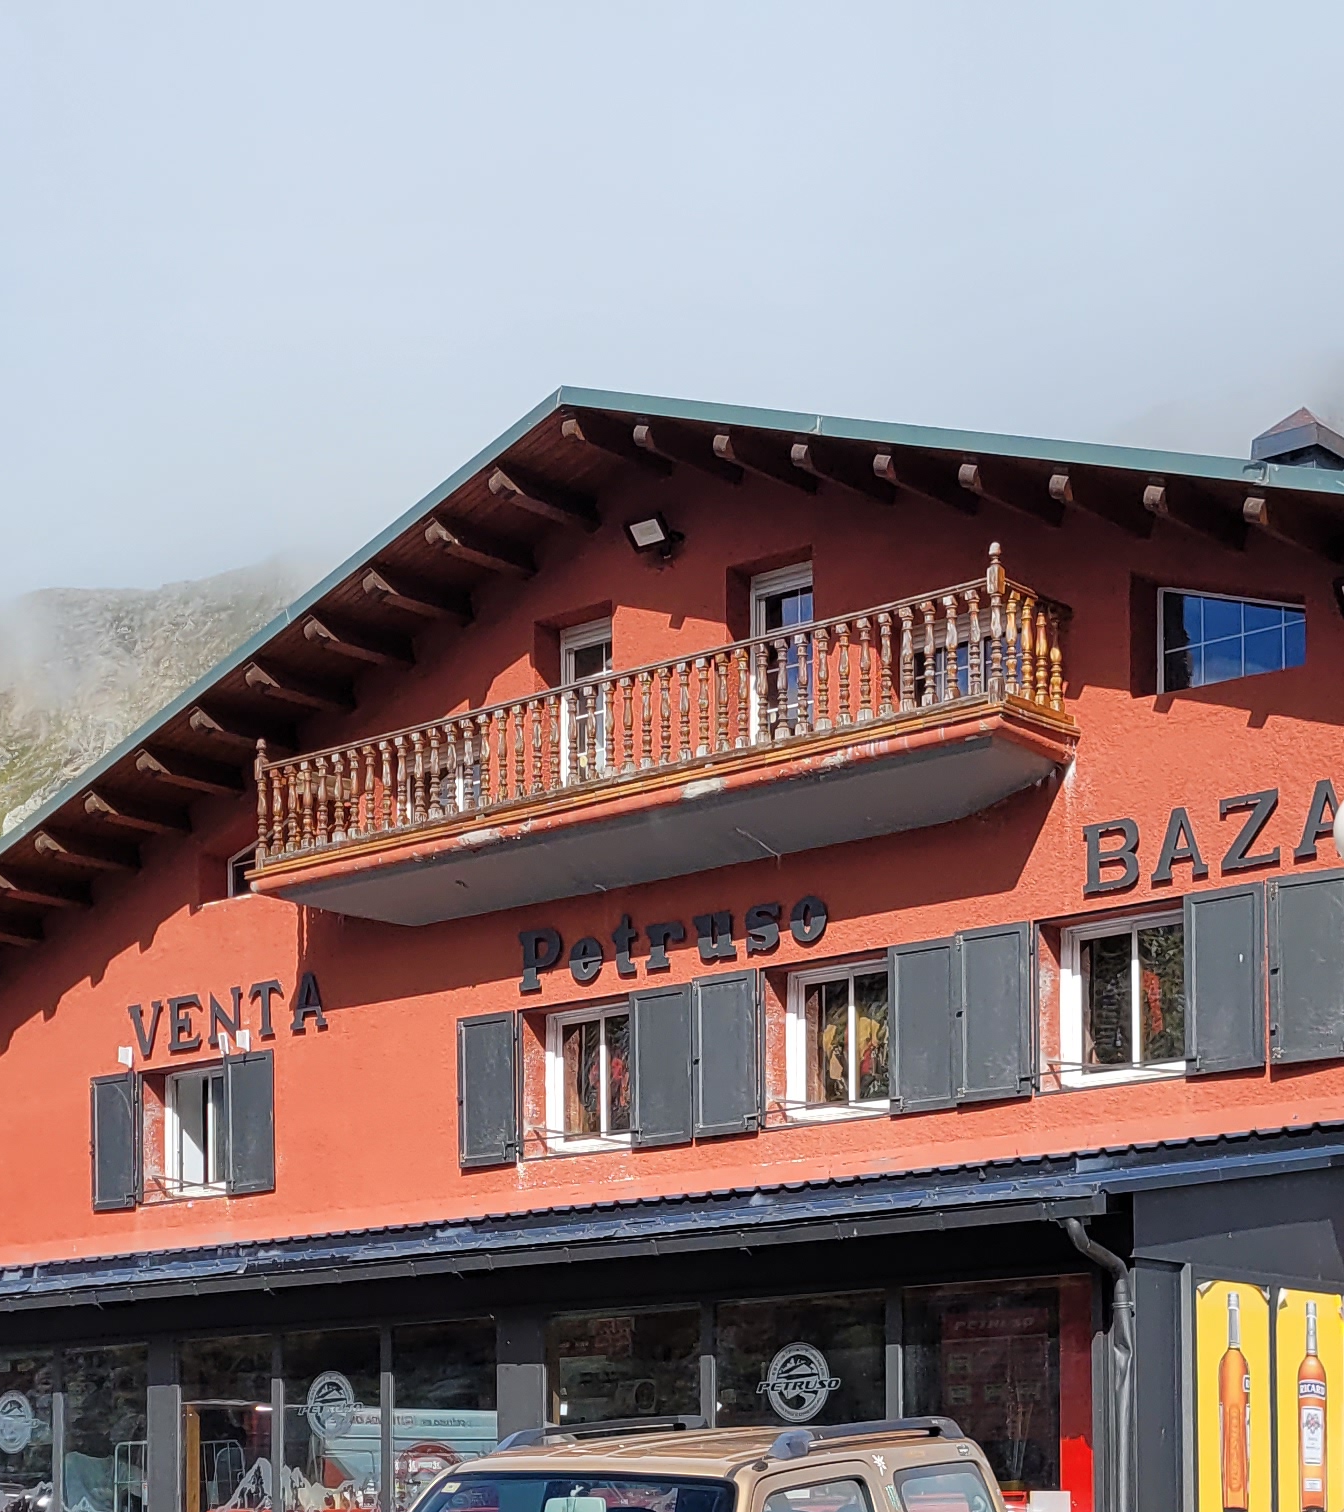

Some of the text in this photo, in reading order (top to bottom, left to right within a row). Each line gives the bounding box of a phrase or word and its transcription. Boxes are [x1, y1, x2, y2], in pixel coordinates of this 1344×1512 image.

[519, 893, 829, 992] Petruso
[128, 972, 328, 1060] VENTA
[756, 1378, 841, 1394] PETRUSO
[1299, 1382, 1326, 1397] RICARD
